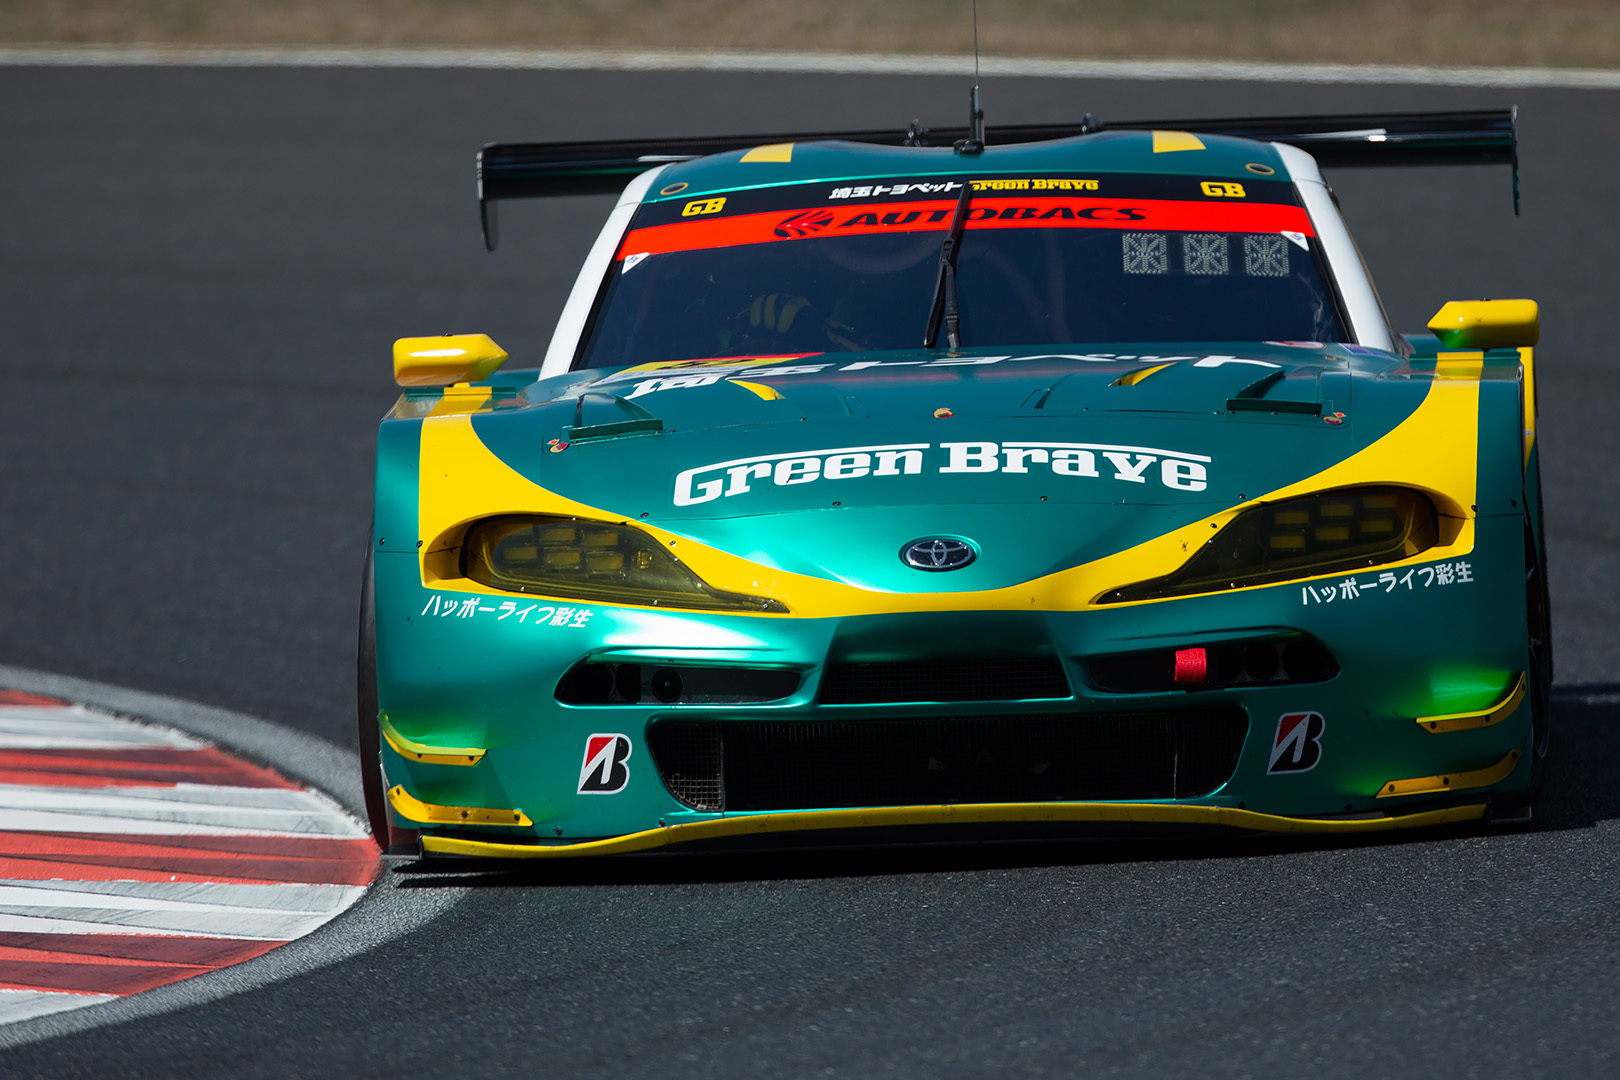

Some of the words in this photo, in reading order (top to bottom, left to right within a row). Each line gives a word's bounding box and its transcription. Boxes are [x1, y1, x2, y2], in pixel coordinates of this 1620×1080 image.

[829, 181, 963, 200] 埼玉トヨペット
[1031, 179, 1099, 190] Brave
[1200, 181, 1246, 198] GB
[681, 197, 727, 217] GB
[836, 207, 1146, 227] AUTOBACS
[673, 443, 930, 507] Green
[938, 441, 1212, 492] Brave
